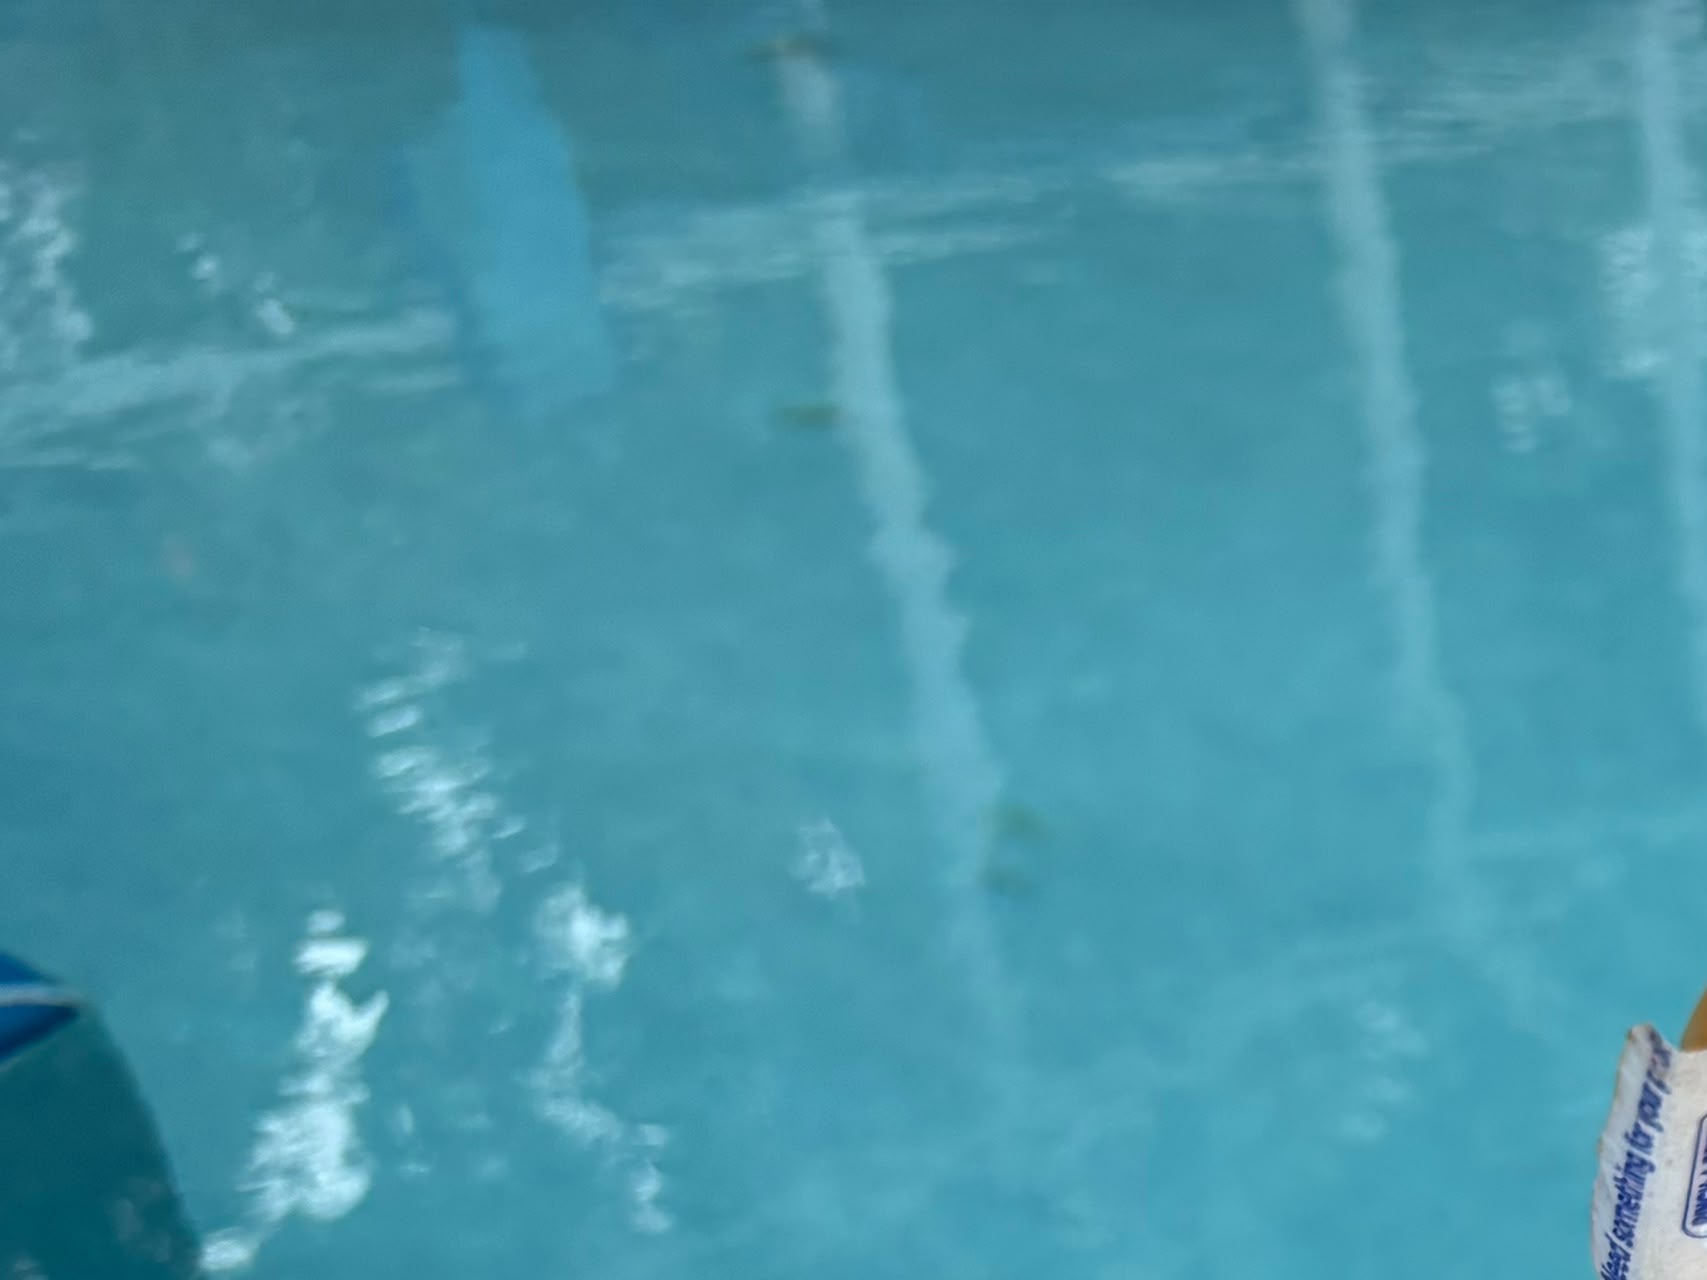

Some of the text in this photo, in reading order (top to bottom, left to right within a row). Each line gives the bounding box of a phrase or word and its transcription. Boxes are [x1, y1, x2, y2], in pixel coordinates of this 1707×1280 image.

[1631, 1079, 1663, 1132] your
[1623, 1123, 1654, 1153] for
[1609, 1150, 1656, 1249] something
